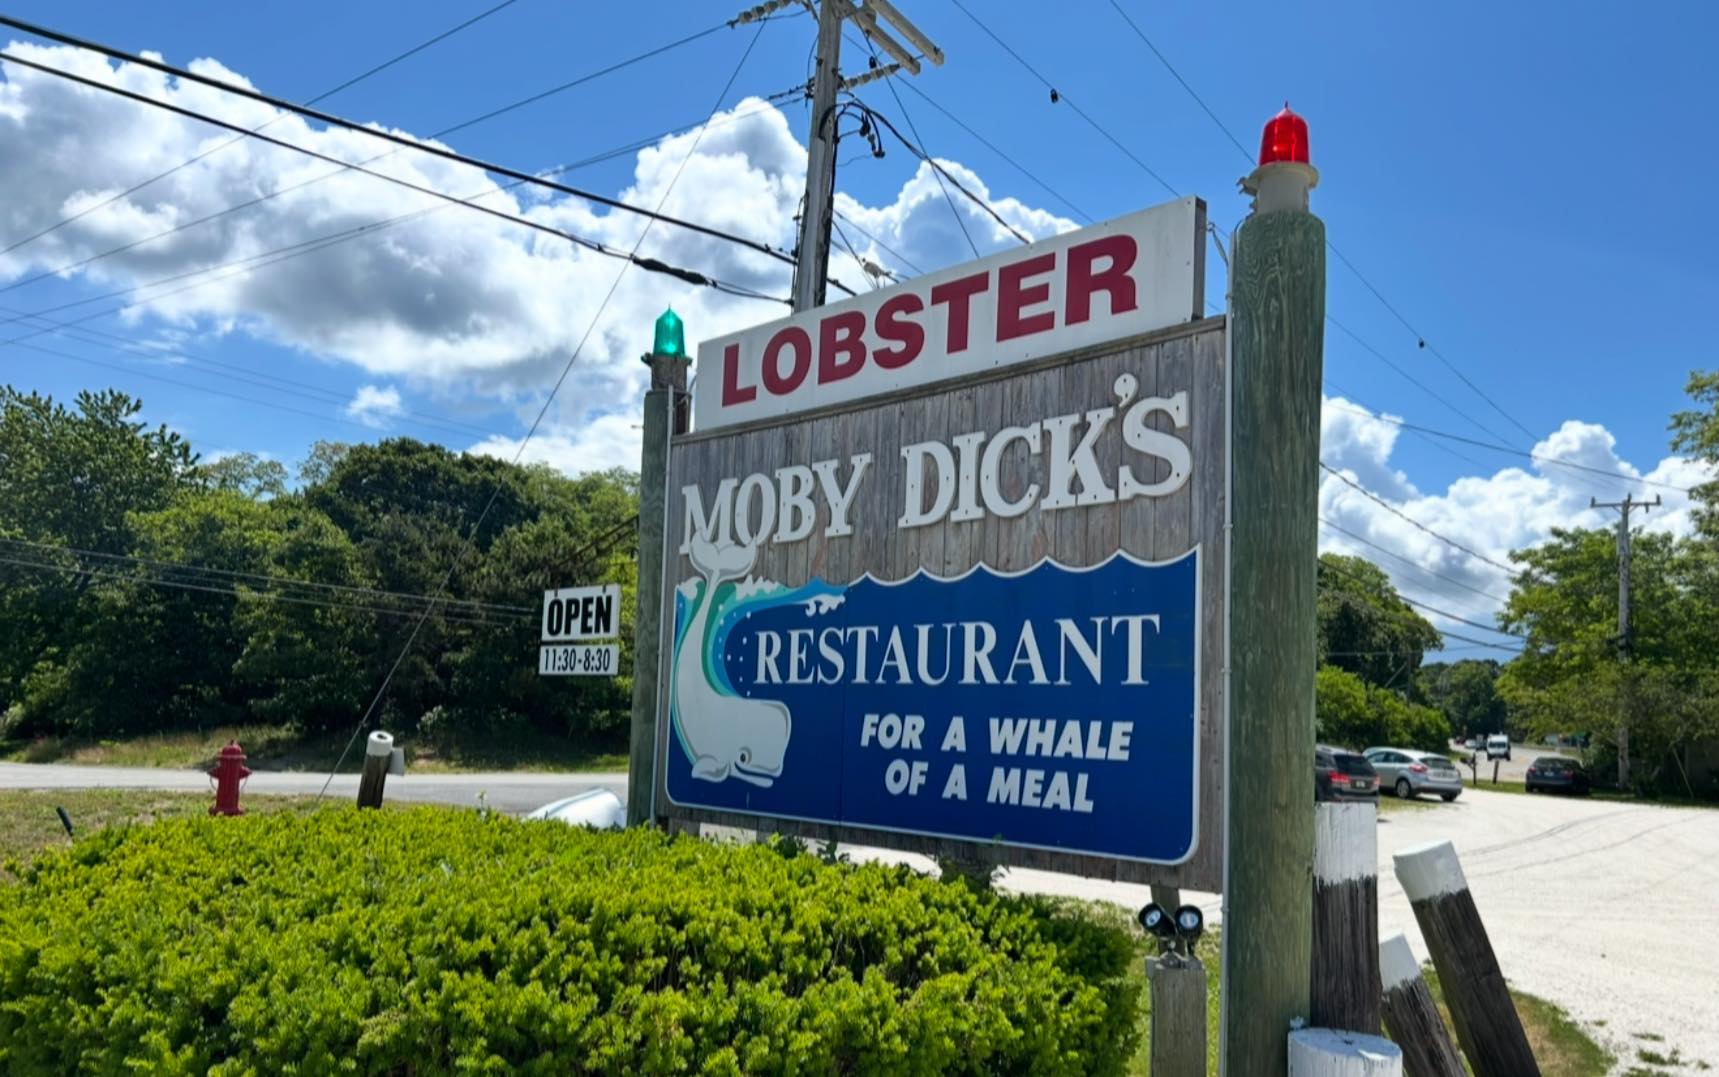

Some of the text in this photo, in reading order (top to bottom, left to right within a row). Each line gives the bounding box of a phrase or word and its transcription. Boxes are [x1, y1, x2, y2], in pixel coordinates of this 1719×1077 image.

[722, 234, 1138, 407] LOBSTER
[680, 373, 1195, 555] MOBY DICK'S
[547, 595, 612, 636] OPEN
[545, 647, 611, 672] 11:30-8:30
[754, 614, 1161, 686] RESTAURANT
[861, 713, 1134, 761] FOR A WHALE
[885, 759, 1094, 813] OF A MEAL
